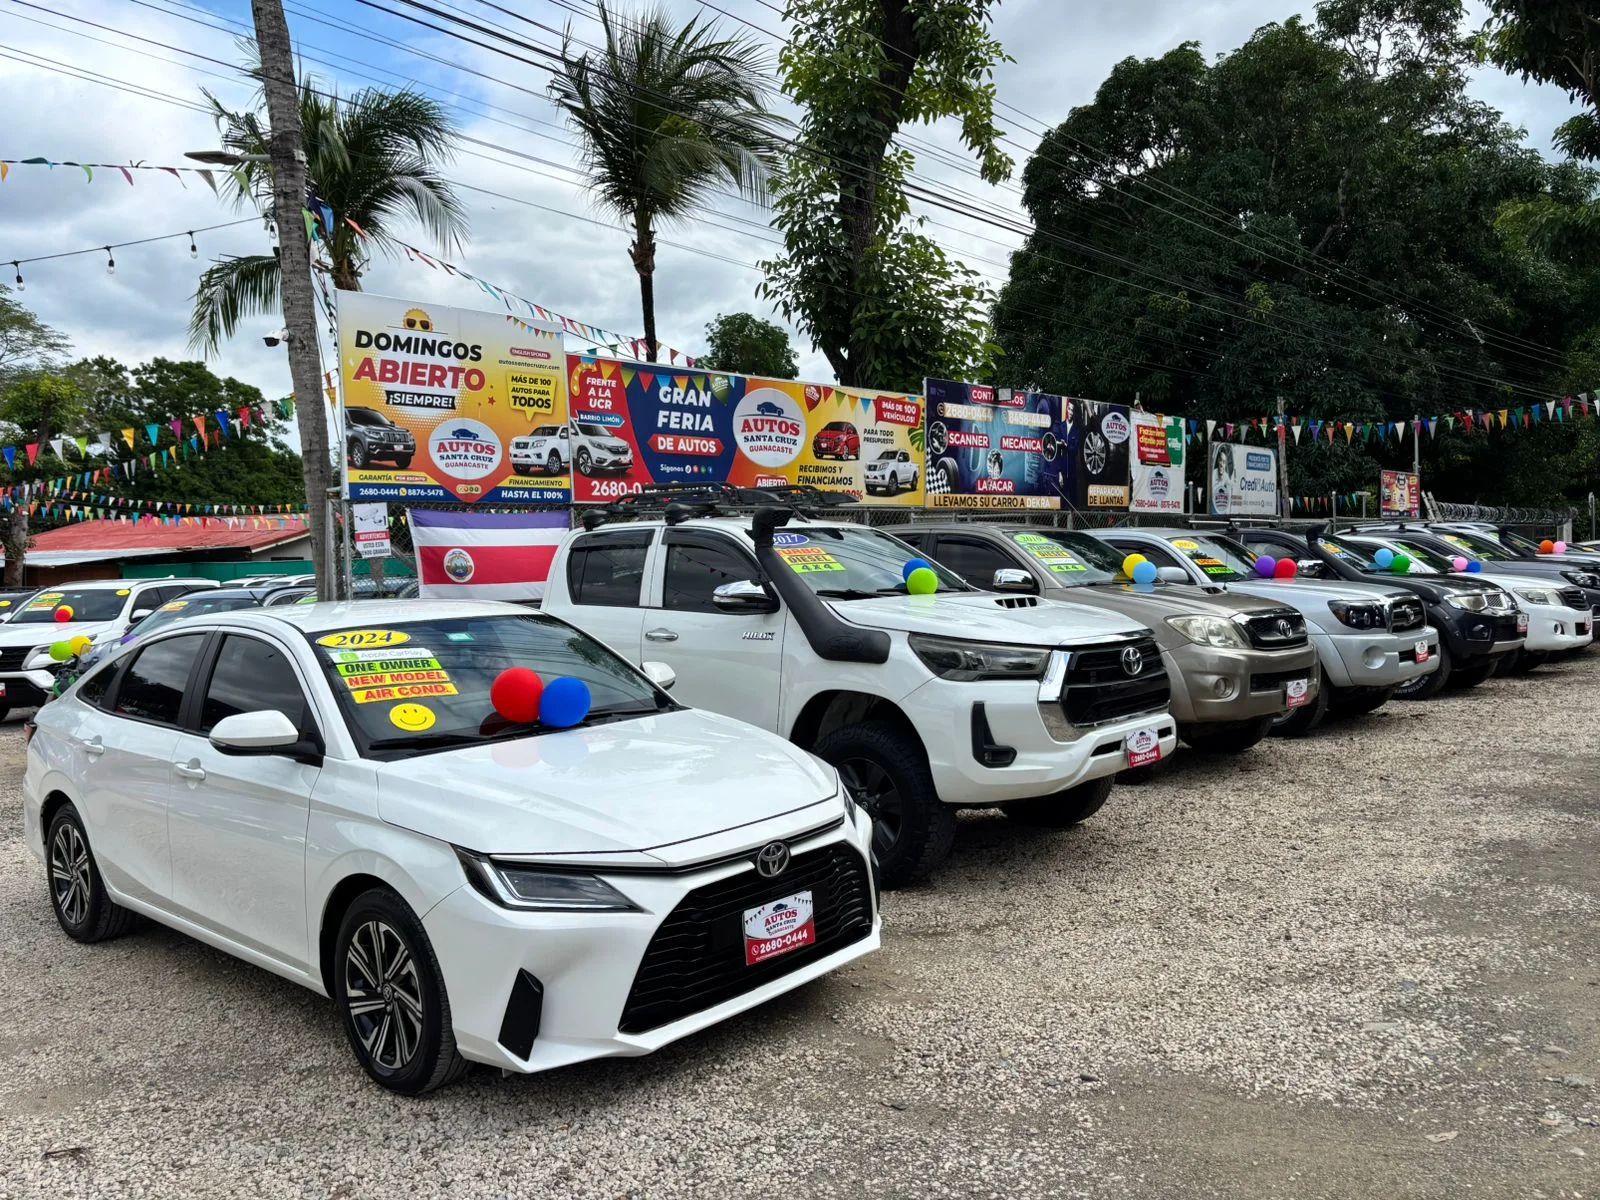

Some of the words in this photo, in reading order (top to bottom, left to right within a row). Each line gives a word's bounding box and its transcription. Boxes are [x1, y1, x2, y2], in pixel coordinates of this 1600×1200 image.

[355, 330, 482, 361] DOMINGOS
[353, 357, 486, 392] ABIERTO
[511, 374, 527, 384] MÁS
[586, 377, 616, 388] FRENTE
[598, 389, 611, 398] LA
[658, 386, 712, 408] GRAN
[389, 392, 452, 408] ¡SIEMPRE!
[512, 396, 551, 409] TODOS
[589, 398, 612, 410] UCR
[904, 405, 916, 414] 100
[580, 414, 600, 422] BARRIO
[602, 415, 620, 423] LIMÓN
[657, 410, 714, 432] FERIA
[741, 418, 800, 436] AUTOS
[1106, 422, 1127, 431] AUTOS
[657, 436, 674, 450] DE
[677, 438, 717, 453] AUTOS
[743, 435, 773, 443] SANTA
[775, 436, 798, 446] CRUZ
[949, 433, 989, 447] SCANNER
[1002, 435, 1042, 451] MECÁNICA
[436, 442, 496, 455] AUTOS
[749, 445, 793, 454] GUANACASTE
[470, 454, 494, 463] CRUZ
[444, 461, 489, 470] GUANACASTE
[799, 465, 836, 473] RECIBIMOS
[508, 478, 563, 487] FINANCIAMIENTO
[756, 478, 787, 487] ABIERTO
[797, 476, 853, 486] FINANCIAMOS
[359, 488, 398, 496] 2680-0444
[591, 480, 655, 497] 2680-0
[501, 490, 529, 499] HASTA
[531, 491, 541, 499] EL
[543, 491, 563, 499] 100%
[1089, 496, 1097, 504] DE
[1100, 496, 1123, 504] LLANTAS
[934, 496, 978, 507] LLEVAMOS
[980, 497, 990, 507] SU
[992, 497, 1019, 507] CARRO
[1020, 498, 1025, 507] A
[1026, 498, 1051, 508] DEKRA
[773, 534, 798, 544] 2017
[335, 632, 393, 646] 2024
[742, 632, 775, 640] HILUX
[361, 650, 386, 660] Apple
[388, 649, 422, 658] CarPlay
[345, 663, 377, 673] ONE
[380, 660, 431, 671] OWNER
[349, 676, 386, 686] NEW
[390, 672, 446, 682] MODEL
[364, 689, 395, 700] AIR
[398, 684, 450, 696] COND.
[764, 909, 798, 927] AUTOS
[766, 922, 782, 932] SANTA
[760, 929, 808, 954] 2680-0444
